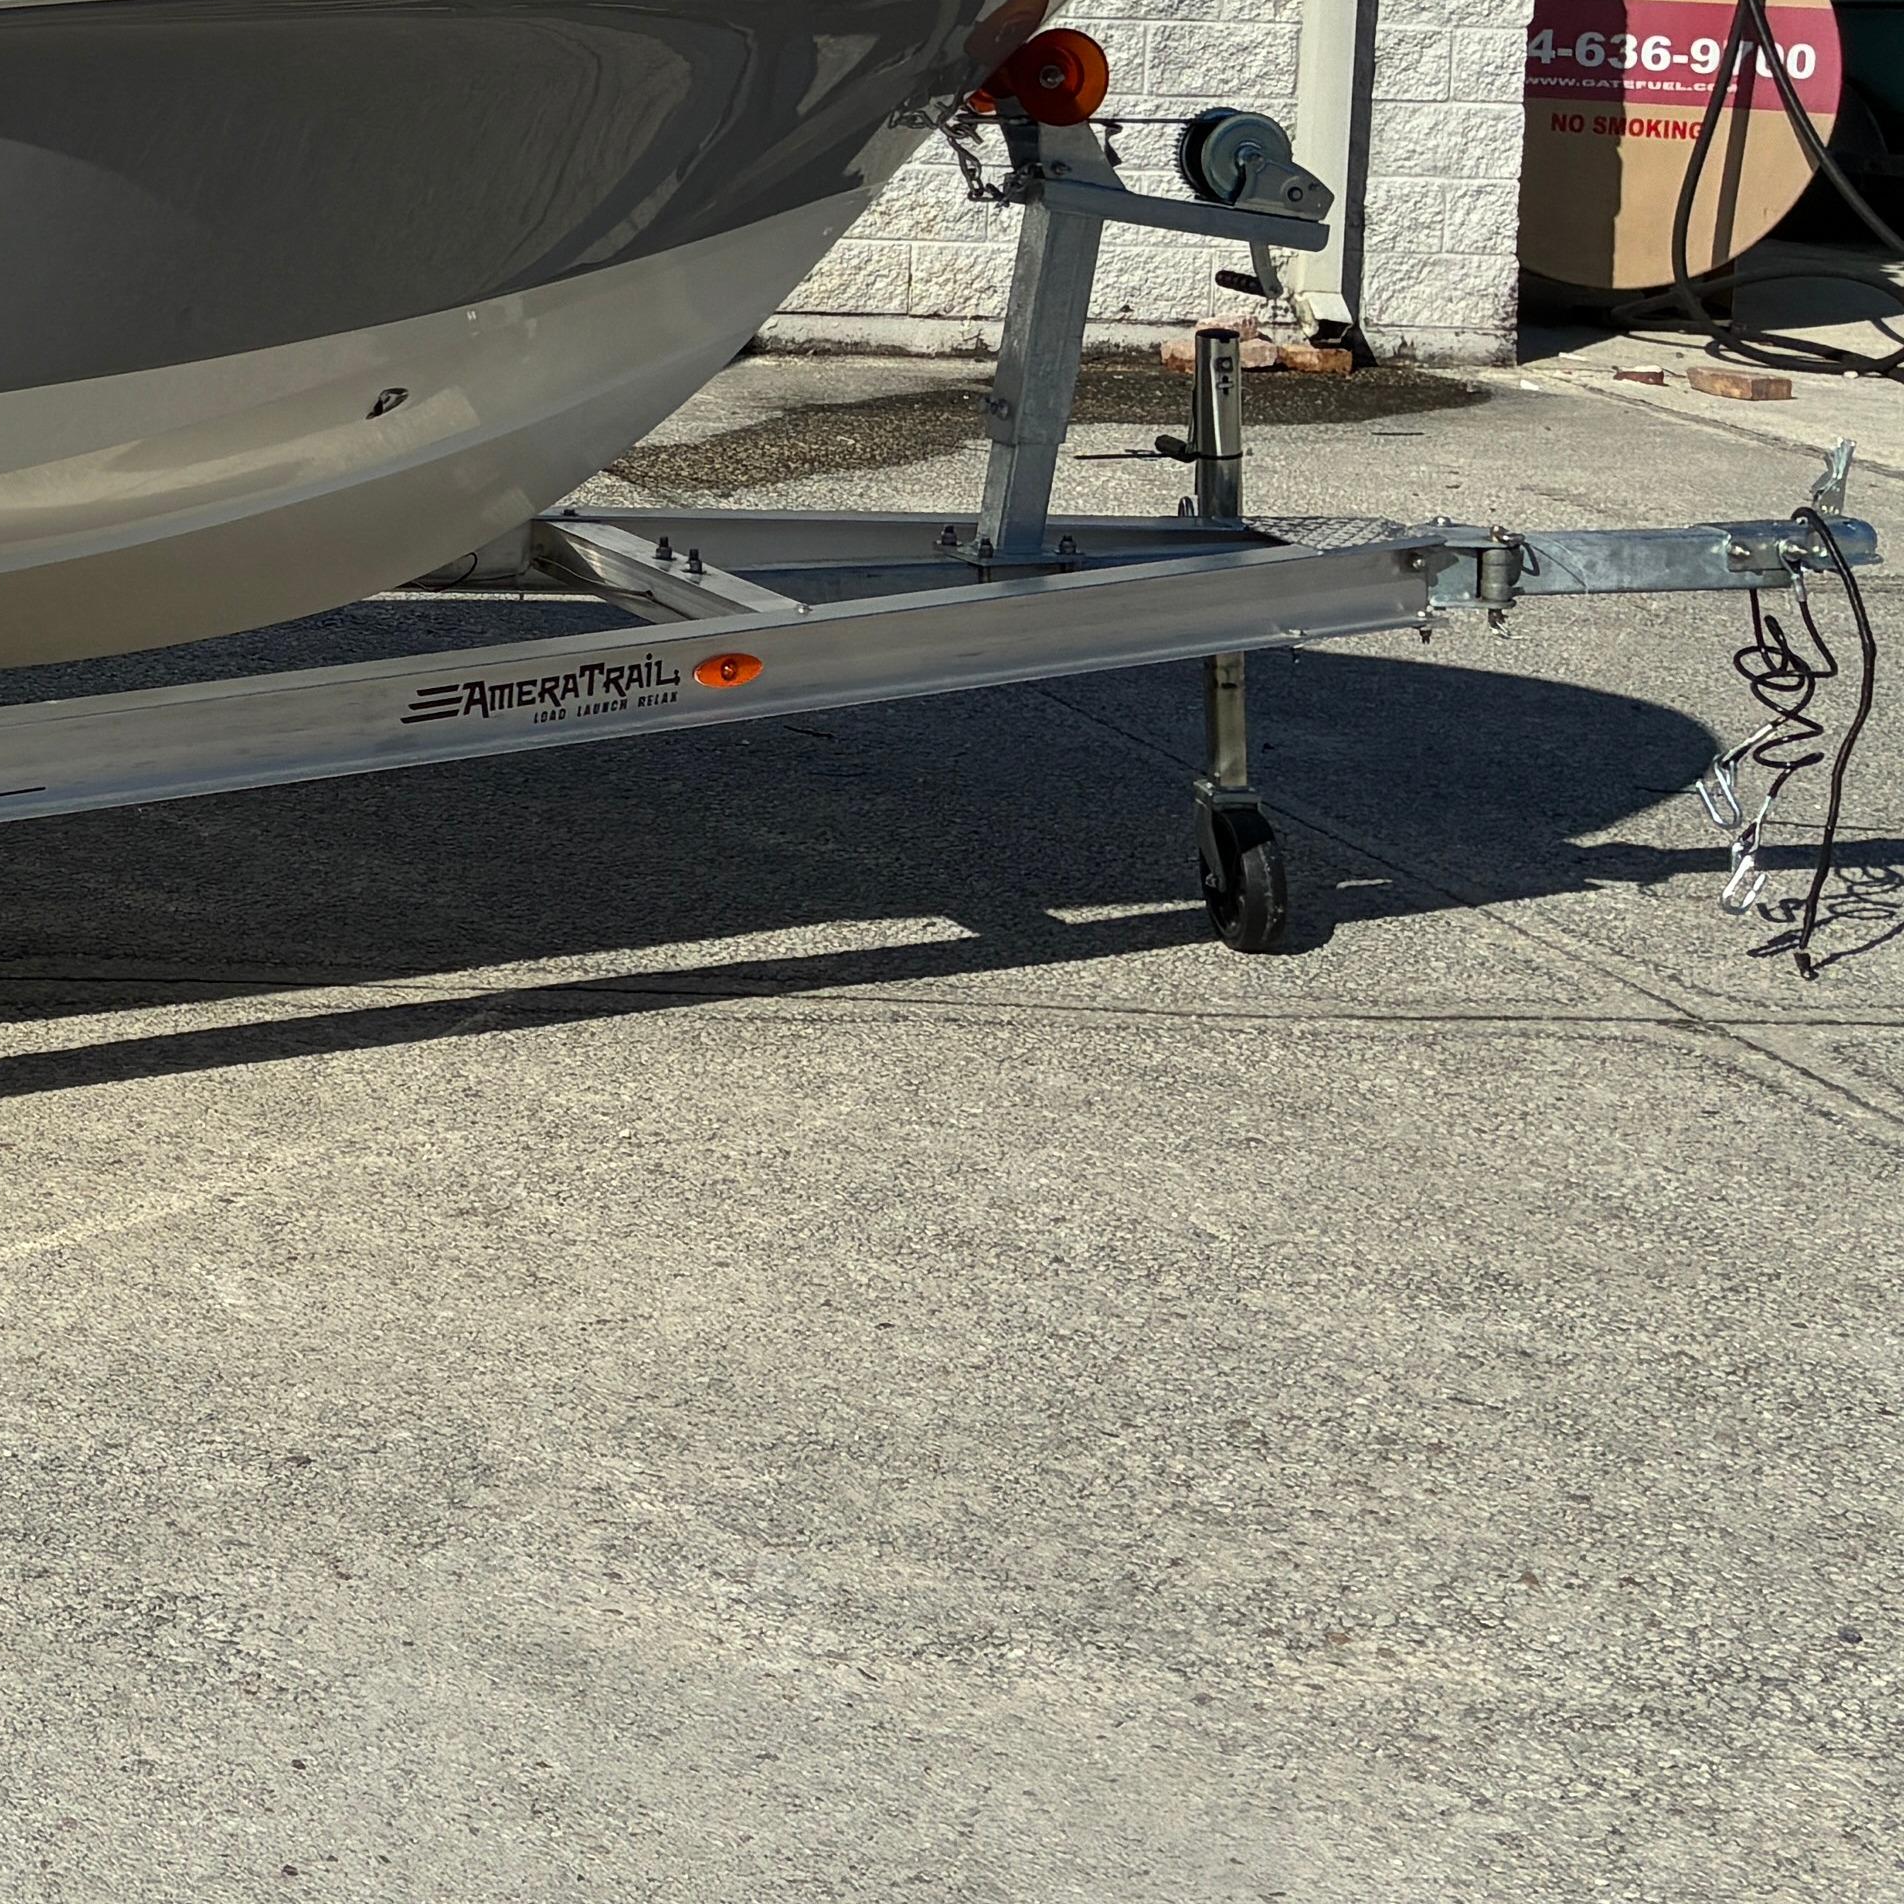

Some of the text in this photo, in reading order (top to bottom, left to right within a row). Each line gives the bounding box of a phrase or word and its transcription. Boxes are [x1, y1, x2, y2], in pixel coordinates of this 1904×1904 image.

[1550, 113, 1704, 140] NO SMOKING
[533, 691, 679, 724] LOAD LAUNCH RELAX
